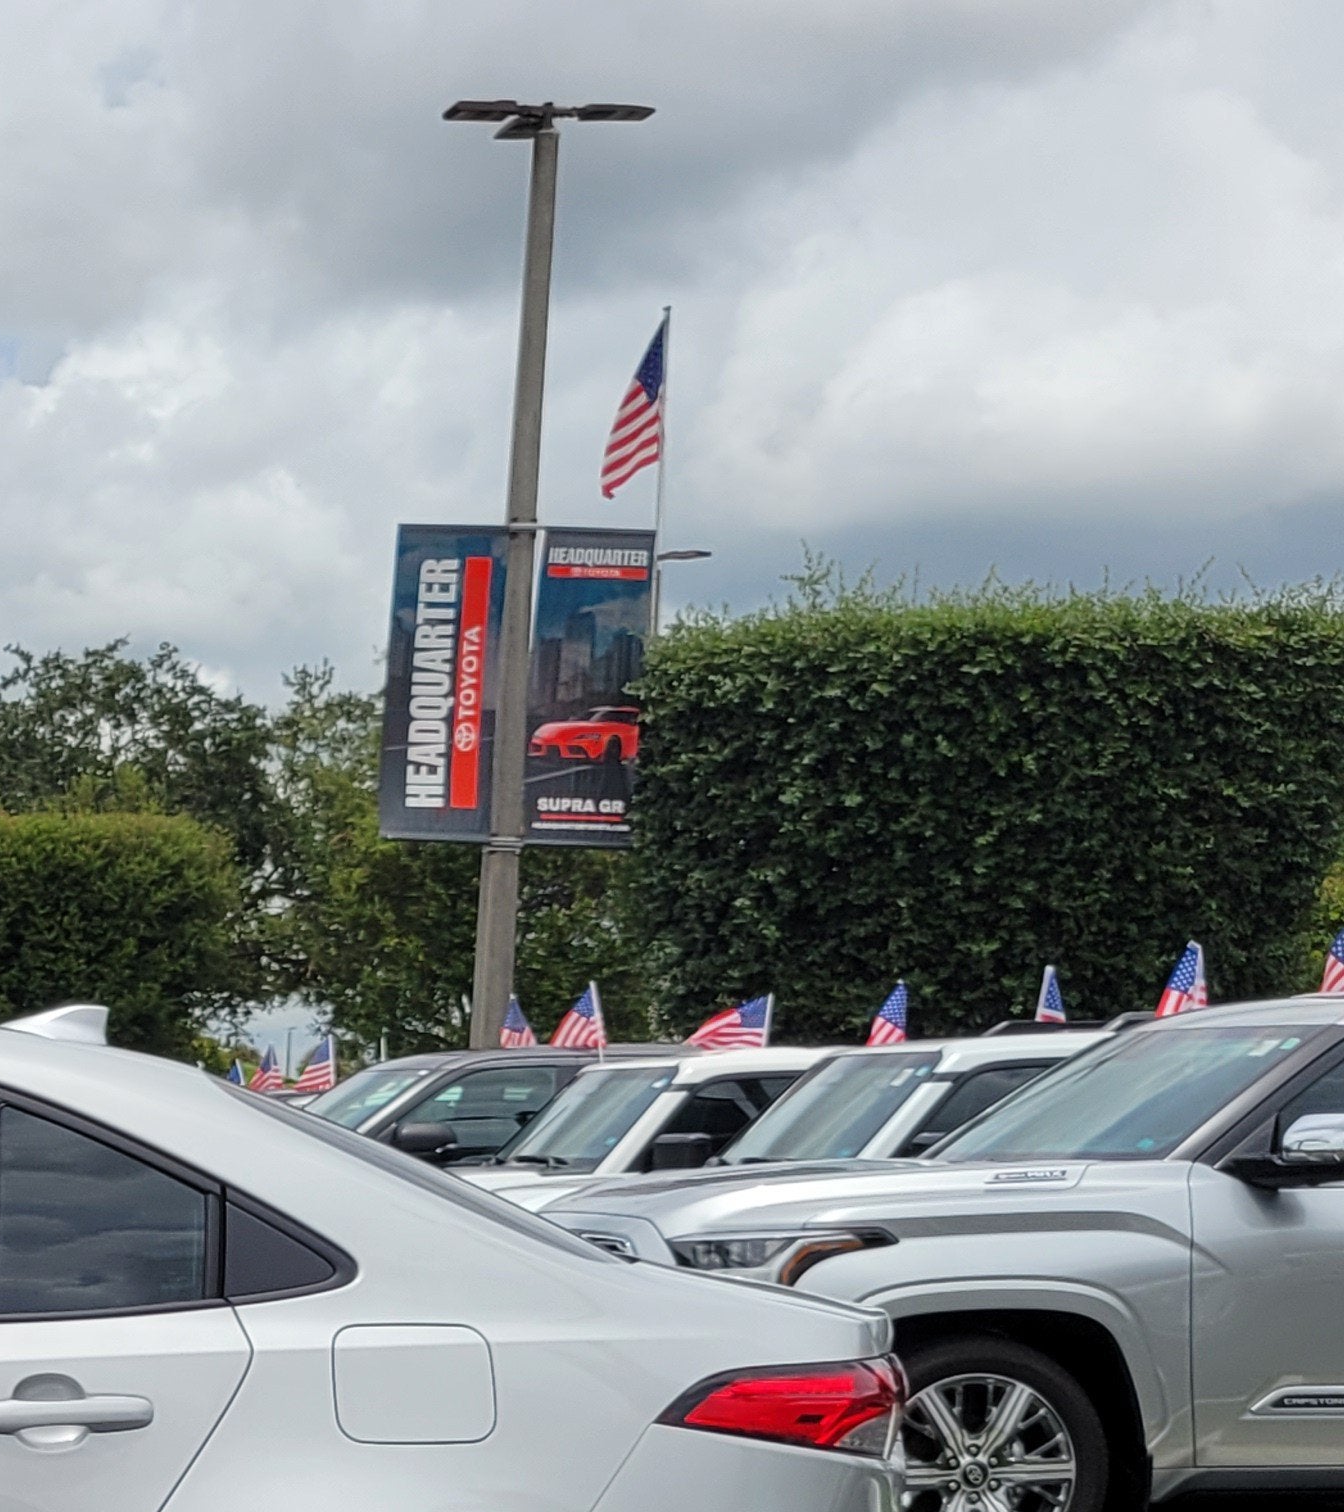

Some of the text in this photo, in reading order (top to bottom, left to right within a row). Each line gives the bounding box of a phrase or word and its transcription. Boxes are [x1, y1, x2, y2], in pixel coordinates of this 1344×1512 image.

[548, 547, 649, 566] HEADQUARTER
[458, 625, 482, 720] TOYOTA
[405, 558, 461, 808] HEADQUARTER
[537, 797, 625, 813] SUPRA GR
[1283, 1398, 1344, 1406] CAPSTON
